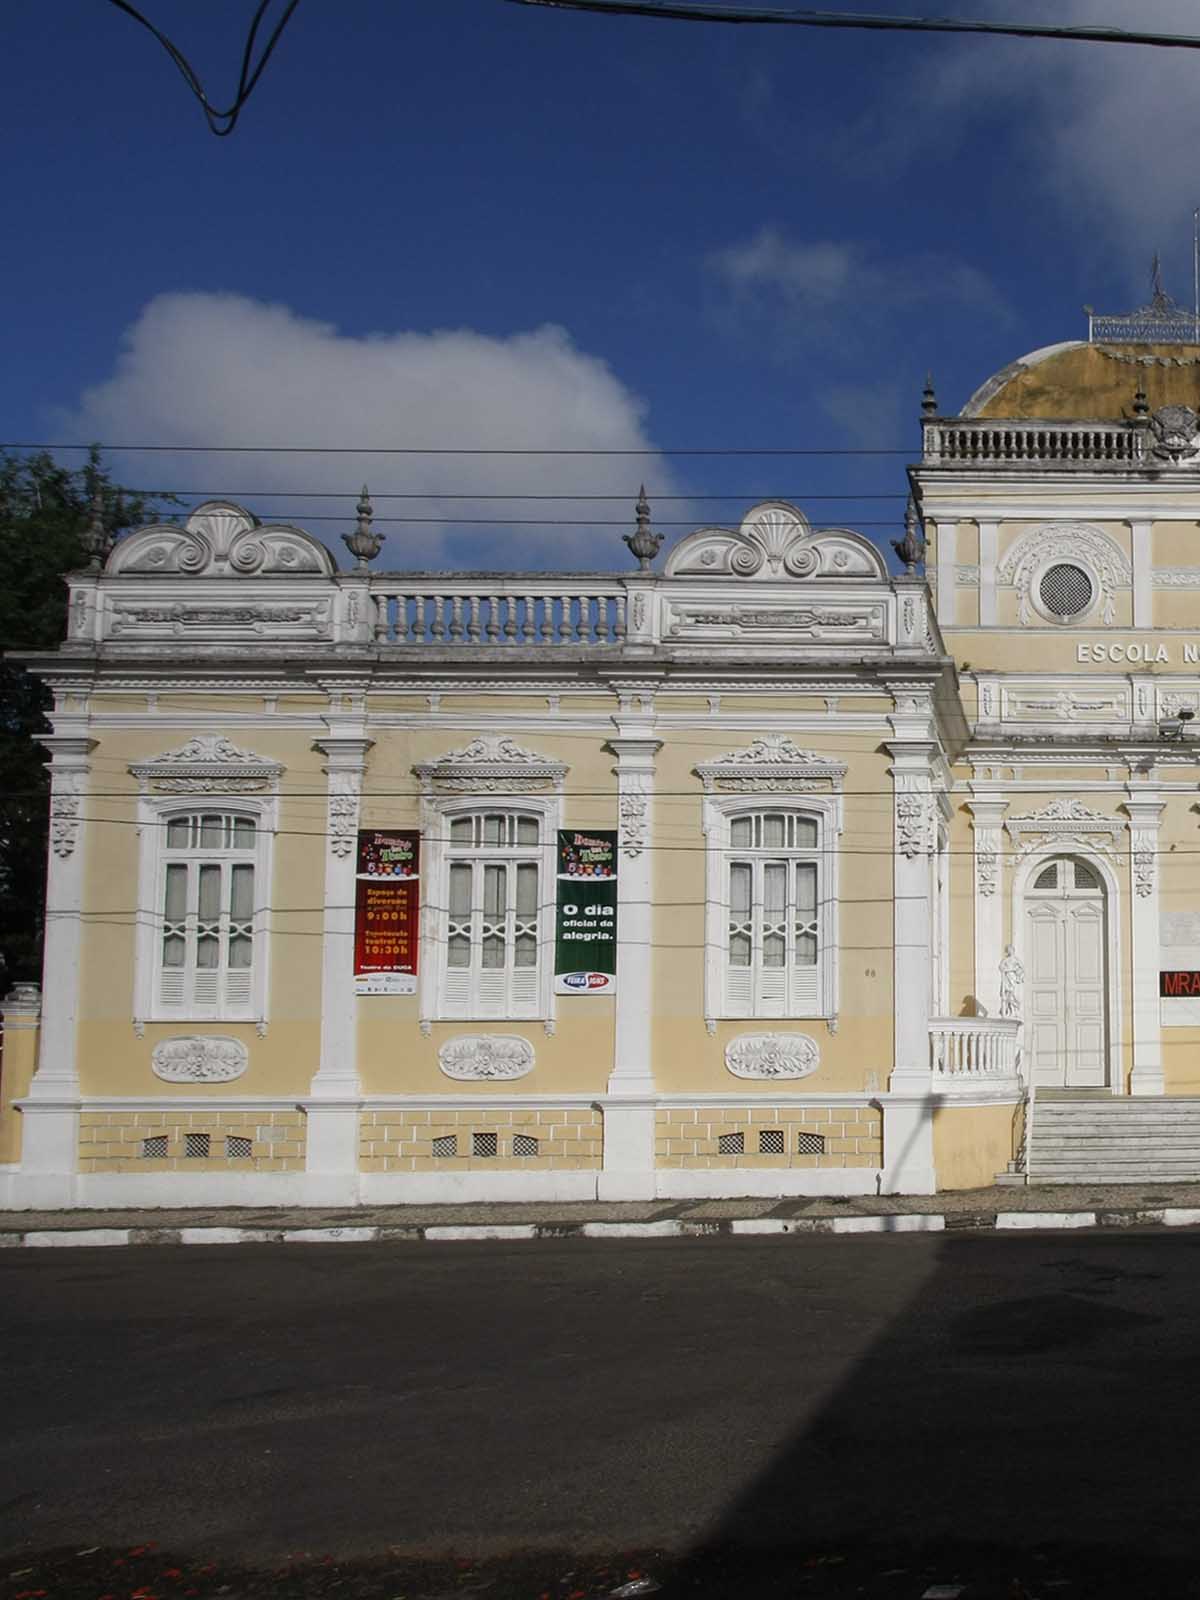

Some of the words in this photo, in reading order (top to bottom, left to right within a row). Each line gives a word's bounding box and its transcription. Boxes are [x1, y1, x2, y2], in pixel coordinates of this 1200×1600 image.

[1077, 643, 1169, 663] ESCOLA
[562, 904, 578, 915] O
[584, 904, 614, 915] dia
[367, 911, 407, 920] 9:00h
[562, 919, 597, 927] oficial
[600, 919, 614, 927] da
[562, 932, 614, 941] alegria.
[365, 945, 408, 954] 10:30h
